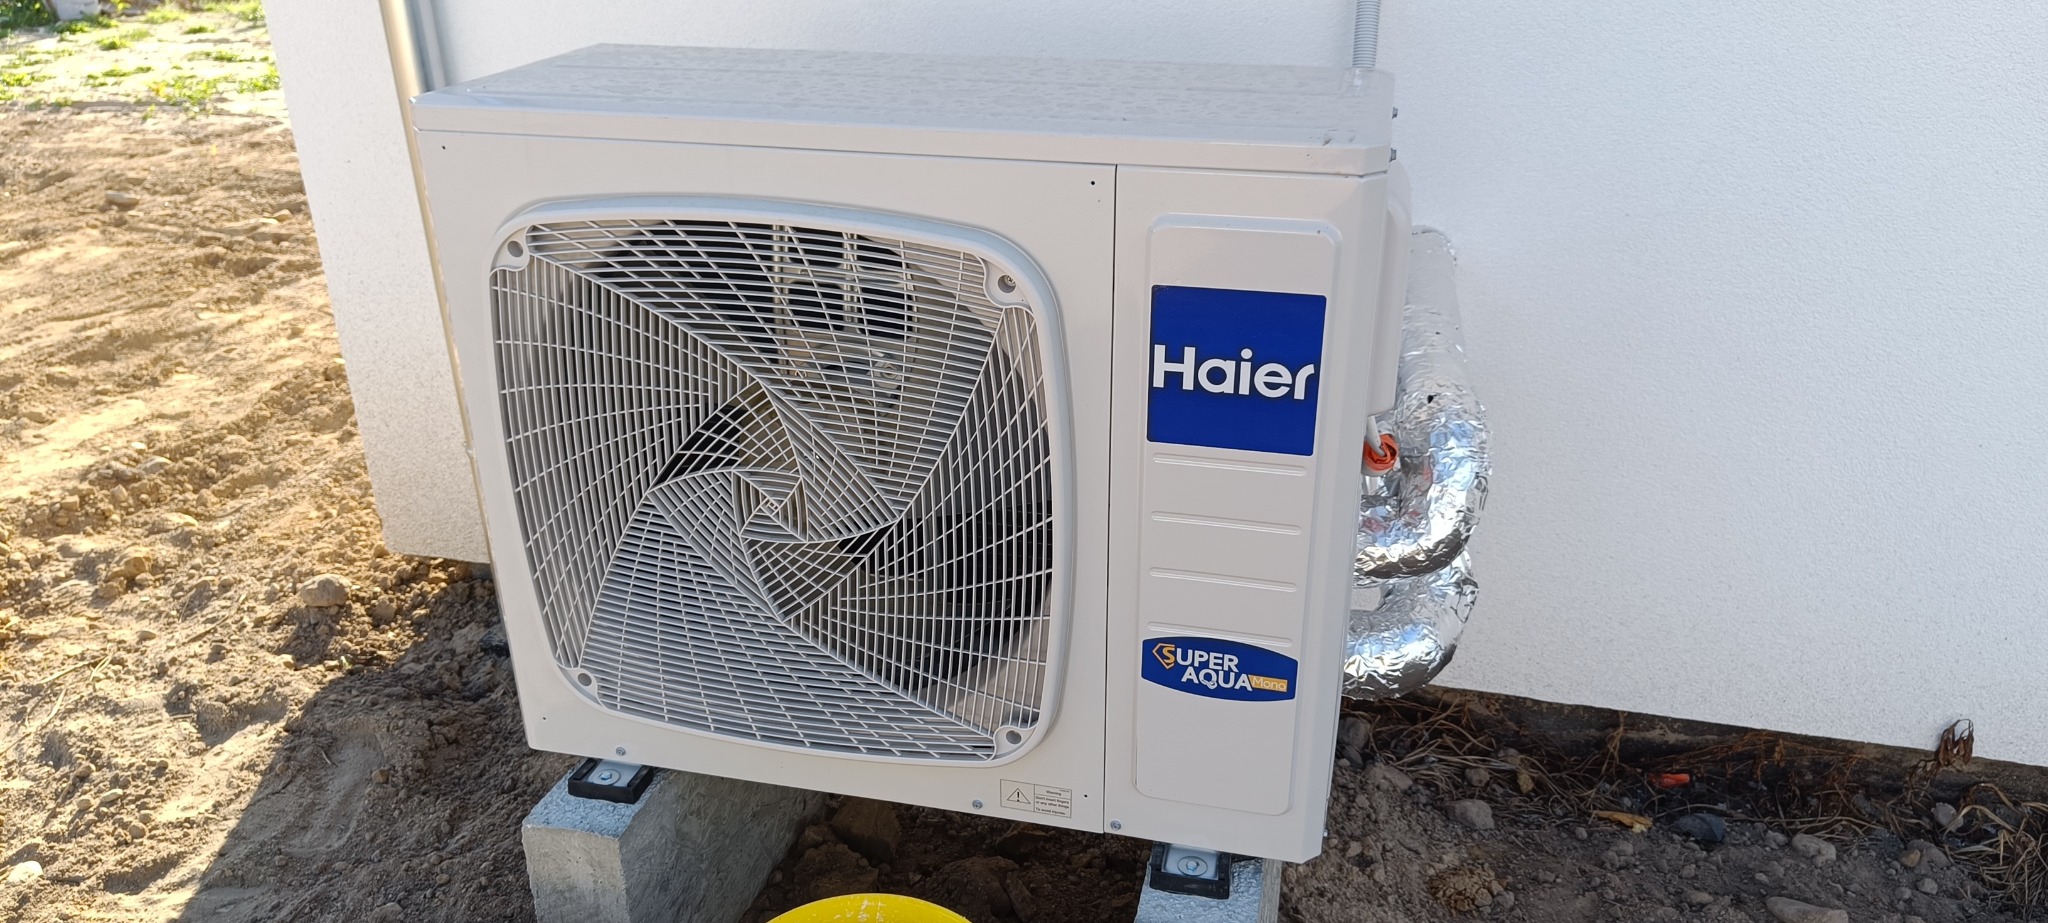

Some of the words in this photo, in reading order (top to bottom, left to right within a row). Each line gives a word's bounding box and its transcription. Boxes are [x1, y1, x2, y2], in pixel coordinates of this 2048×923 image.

[1152, 344, 1315, 400] Haier
[1161, 645, 1239, 672] SUPER
[1181, 666, 1252, 691] AQUA
[1252, 676, 1287, 691] Mono
